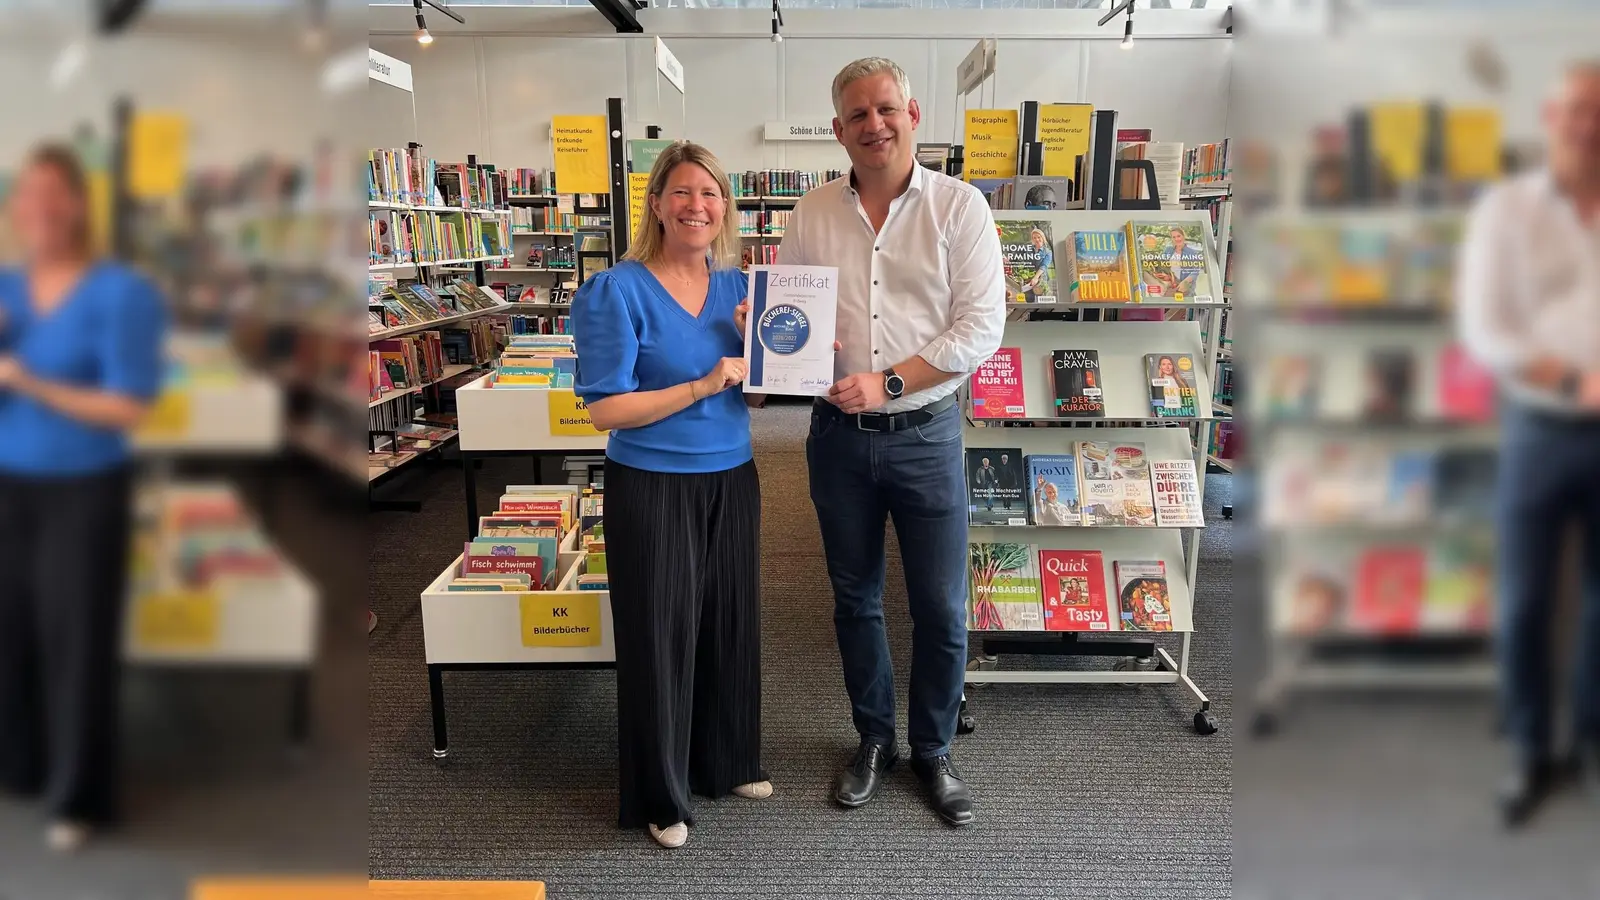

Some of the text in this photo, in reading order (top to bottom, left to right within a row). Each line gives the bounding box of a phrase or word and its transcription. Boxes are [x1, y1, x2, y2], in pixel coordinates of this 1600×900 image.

[971, 116, 1008, 126] Biographie
[790, 126, 812, 136] Schöne
[972, 133, 992, 141] Musik
[970, 150, 1008, 159] Geschichte
[970, 168, 997, 176] Religion
[1084, 233, 1117, 252] VILLA
[770, 273, 830, 290] Zertifikat
[1080, 281, 1128, 300] RIVOLTA
[763, 306, 808, 328] BÜCHEREI-SIEGEL
[1064, 352, 1088, 360] M.W.
[980, 362, 1015, 370] PANIK,
[1054, 360, 1099, 369] CRAVEN
[1164, 388, 1196, 396] AKTIEN
[1034, 466, 1053, 475] Leo
[1156, 480, 1196, 492] DÜRRE
[1167, 494, 1196, 504] FLUT
[1046, 558, 1089, 575] Quick
[977, 586, 1037, 594] RHABARBER
[1050, 596, 1058, 606] &
[552, 608, 568, 617] KK
[1067, 608, 1103, 621] Tasty
[533, 625, 590, 634] Bilderbücher
